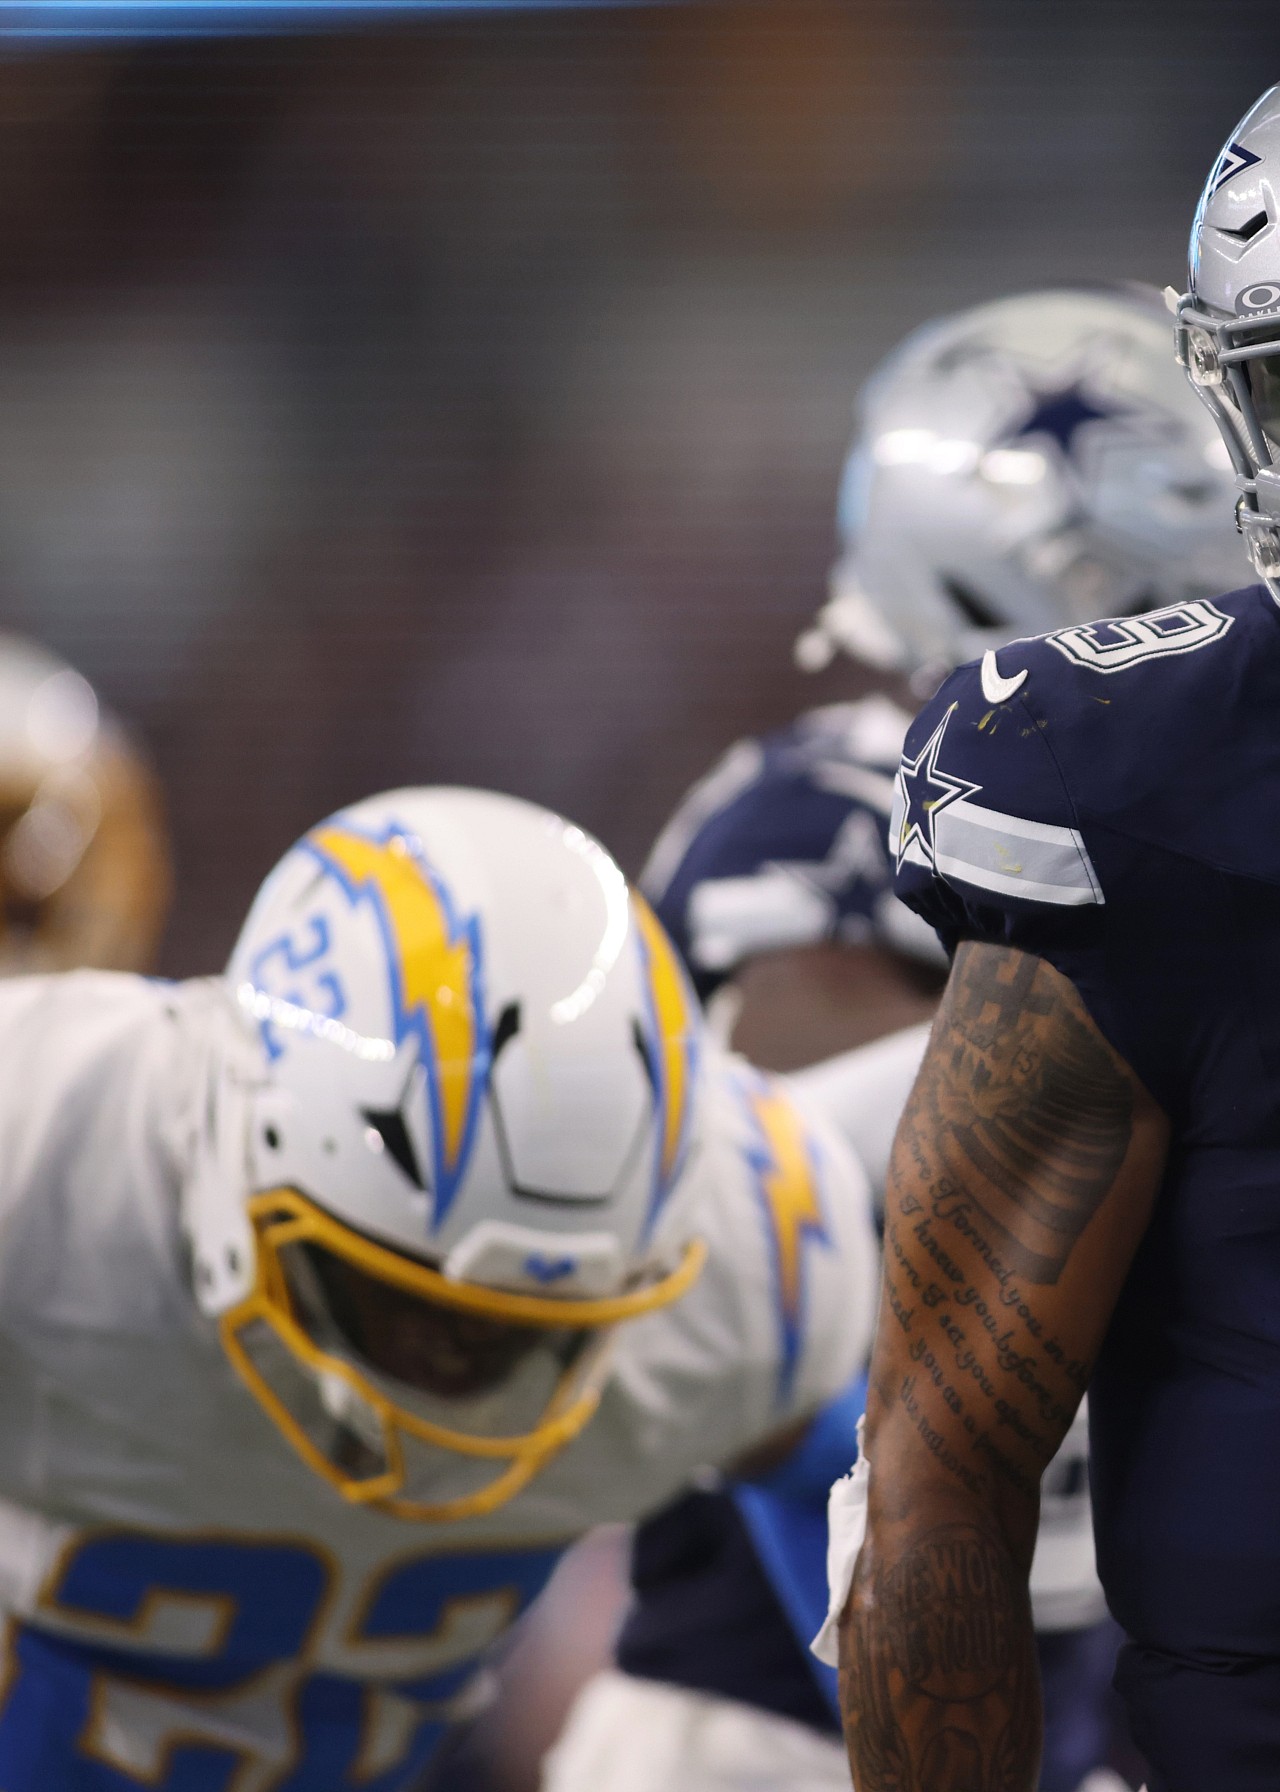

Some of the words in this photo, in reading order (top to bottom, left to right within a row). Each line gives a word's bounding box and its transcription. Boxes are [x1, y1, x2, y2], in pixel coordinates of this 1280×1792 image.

[999, 1284, 1043, 1338] you
[908, 1336, 944, 1388] you
[955, 1350, 996, 1398] you
